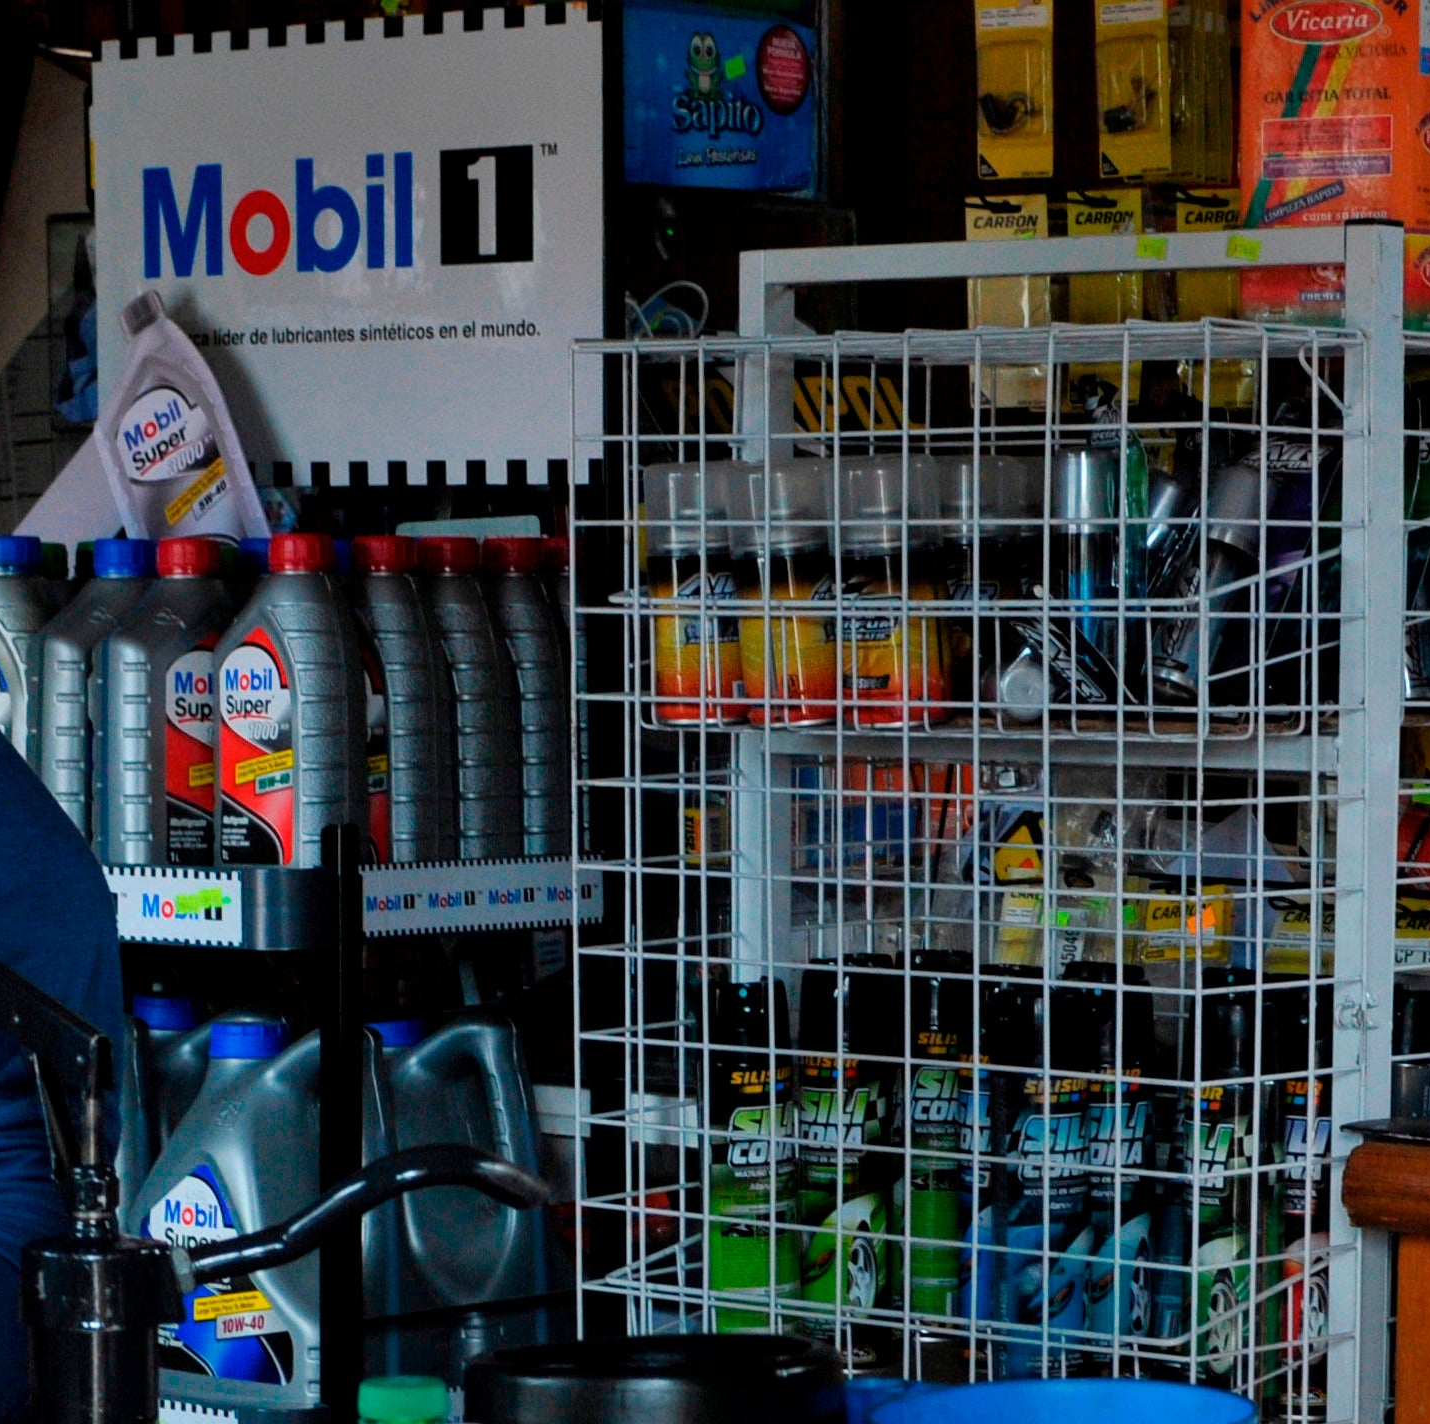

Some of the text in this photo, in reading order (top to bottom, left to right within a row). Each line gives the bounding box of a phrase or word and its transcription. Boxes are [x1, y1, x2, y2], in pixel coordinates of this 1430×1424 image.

[1285, 3, 1369, 32] Vicaria
[1343, 87, 1392, 100] TOTAL
[672, 92, 763, 137] Sapito
[142, 152, 414, 278] Mobil
[973, 215, 1039, 230] CARBON
[1075, 210, 1134, 225] CARBON
[213, 328, 245, 347] líder
[249, 329, 268, 345] de
[272, 326, 356, 345] lubricantes
[359, 322, 435, 342] sintéticos
[438, 324, 458, 340] en
[462, 321, 476, 339] el
[480, 318, 541, 339] mundo.
[123, 399, 182, 451] Mobil
[132, 425, 187, 472] Super
[224, 667, 273, 692] Mobil
[226, 694, 271, 720] Super
[366, 895, 401, 913] Mobil
[428, 892, 462, 910] Mobil
[489, 888, 521, 905] Mobil
[164, 1198, 218, 1229] Mobil
[222, 1314, 265, 1334] 10W-40
